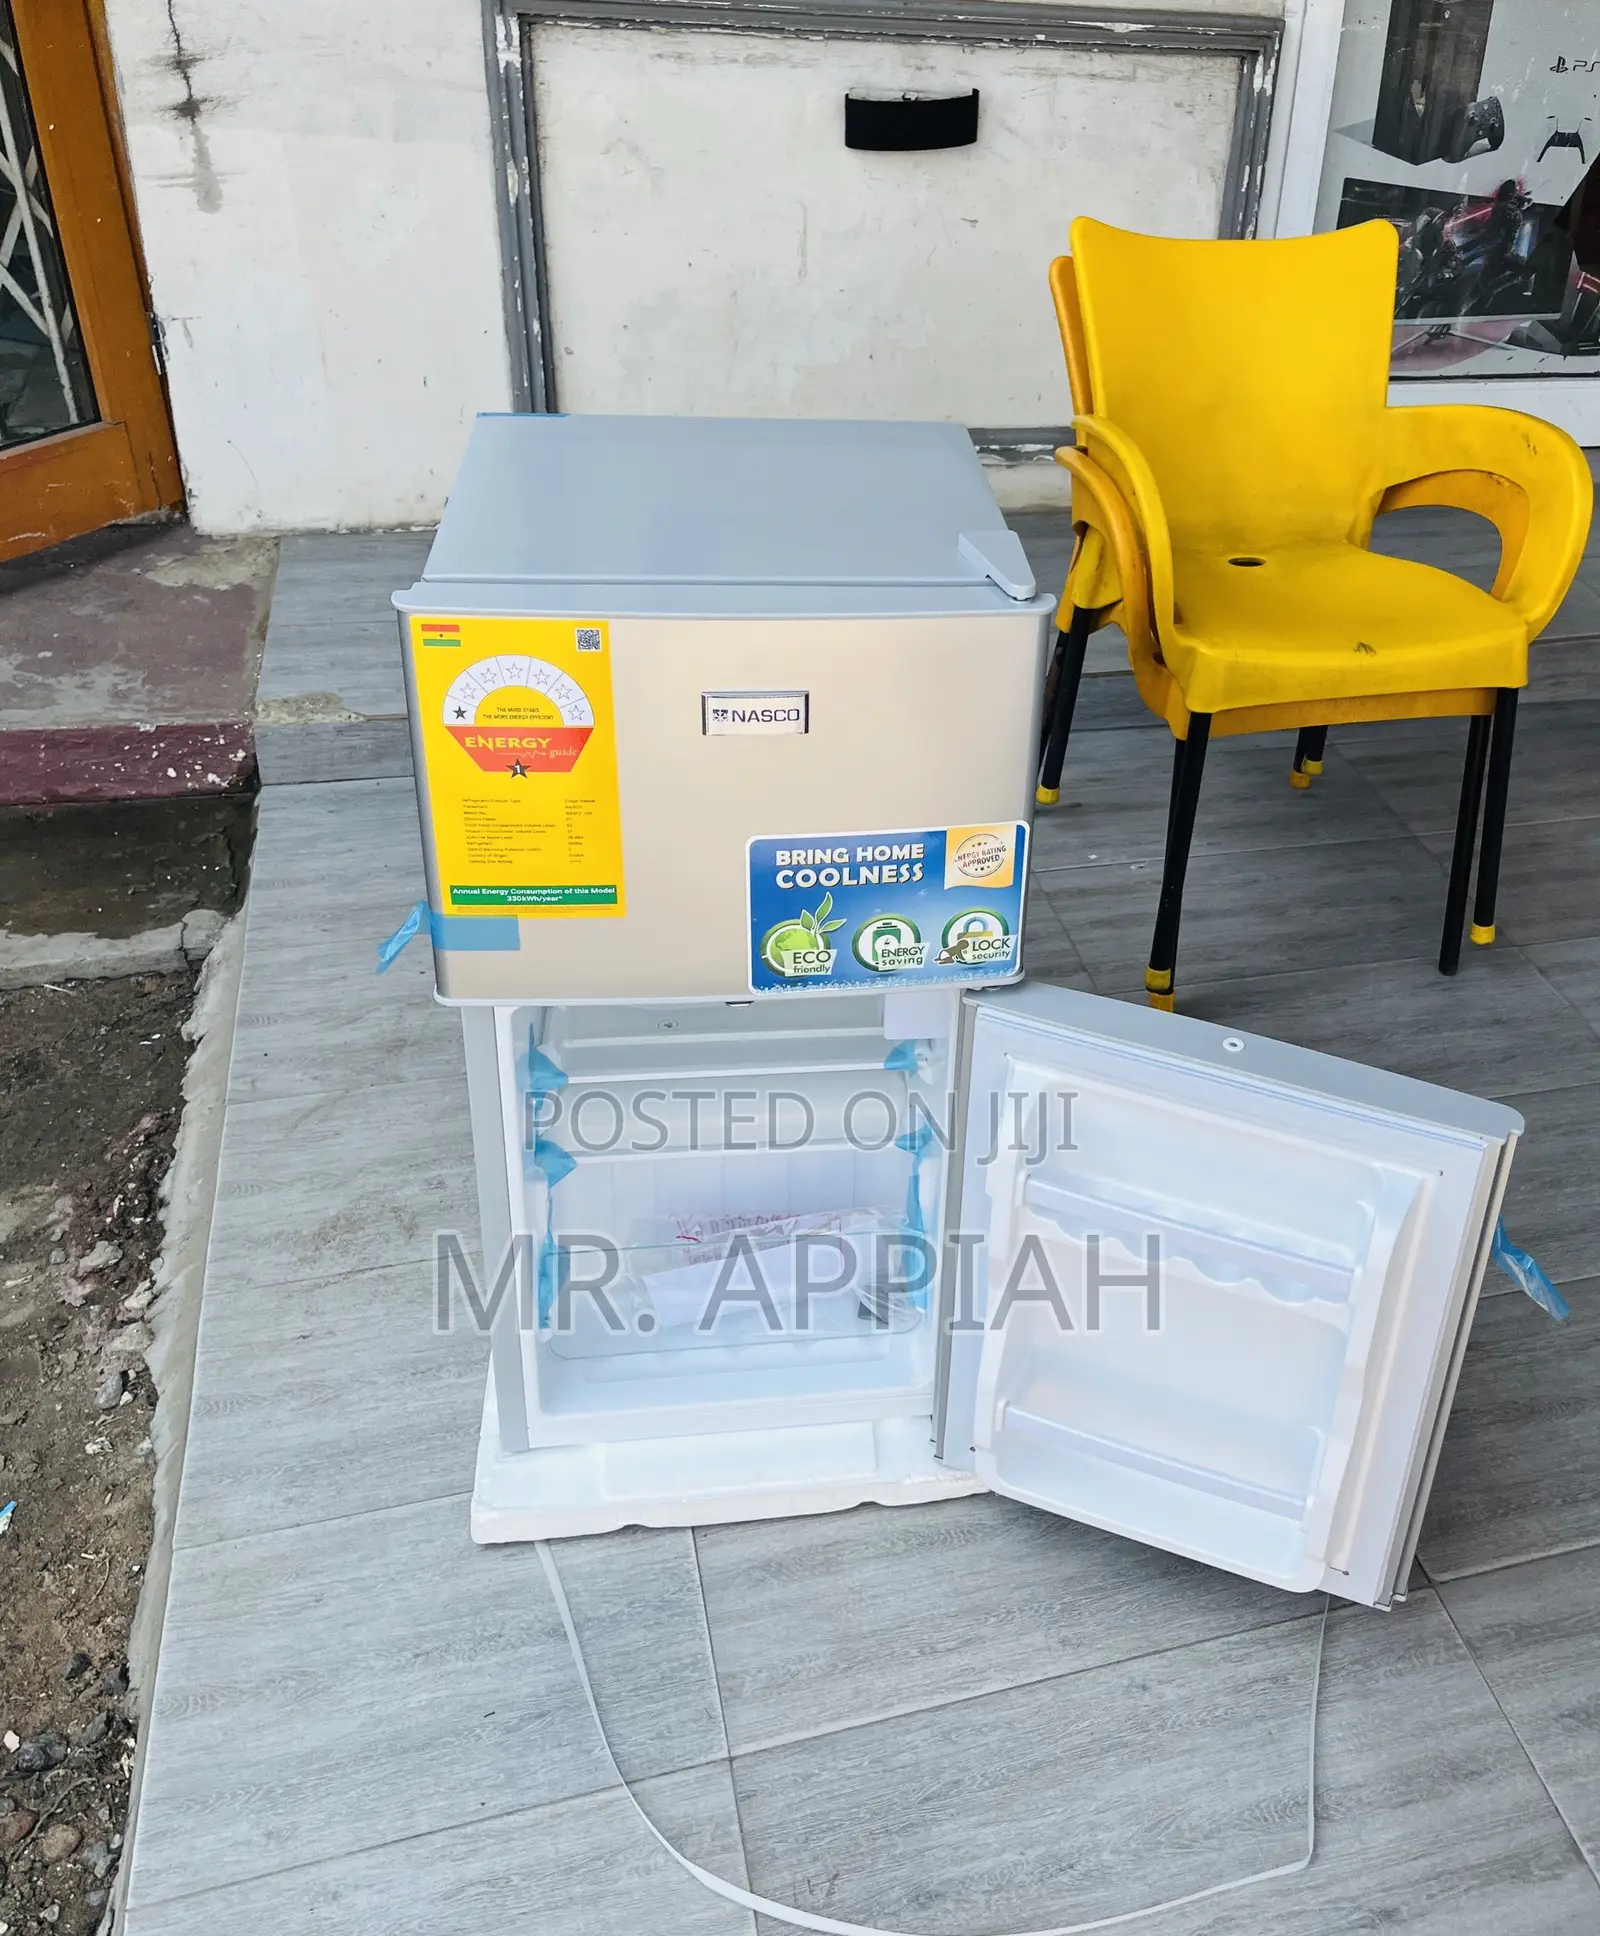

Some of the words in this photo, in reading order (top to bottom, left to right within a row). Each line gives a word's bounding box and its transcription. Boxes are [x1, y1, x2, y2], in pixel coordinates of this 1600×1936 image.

[732, 709, 800, 723] NASCO
[465, 734, 552, 752] ENERGY
[549, 746, 577, 759] guide
[514, 764, 521, 773] 1
[776, 847, 848, 867] BRING
[856, 843, 925, 863] HOME
[982, 844, 1007, 856] RATING
[963, 854, 1000, 868] APPROVED
[776, 862, 924, 890] COOLNESS
[482, 888, 509, 896] Energy
[510, 887, 562, 896] Consumption
[972, 937, 1011, 952] LOCK
[793, 950, 831, 964] ECO
[881, 946, 925, 958] ENERGY
[972, 950, 1011, 961] security
[882, 956, 923, 966] saving
[793, 964, 831, 974] friendly
